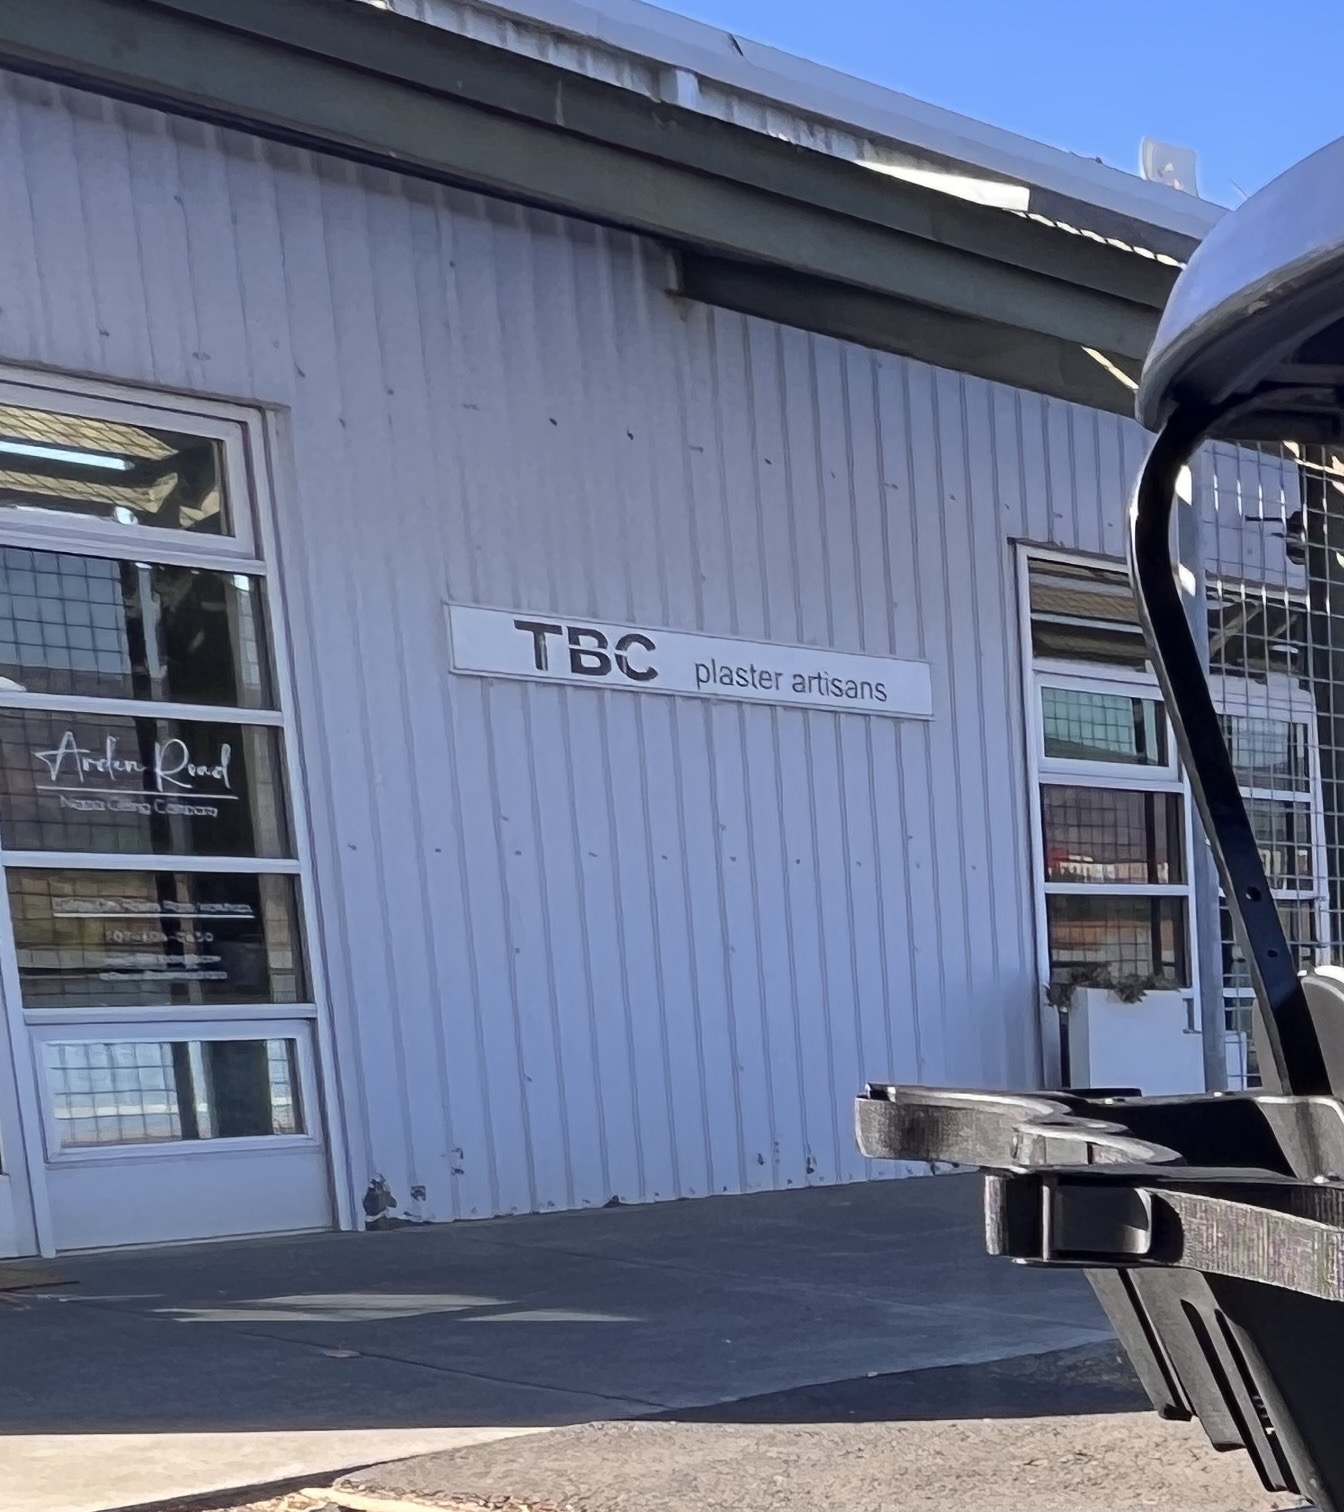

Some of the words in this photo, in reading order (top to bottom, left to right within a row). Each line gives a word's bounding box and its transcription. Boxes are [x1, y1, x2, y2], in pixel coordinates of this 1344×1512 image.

[513, 619, 659, 682] TBC
[694, 658, 783, 690] plaster
[792, 671, 888, 702] artisans
[154, 738, 231, 792] Road
